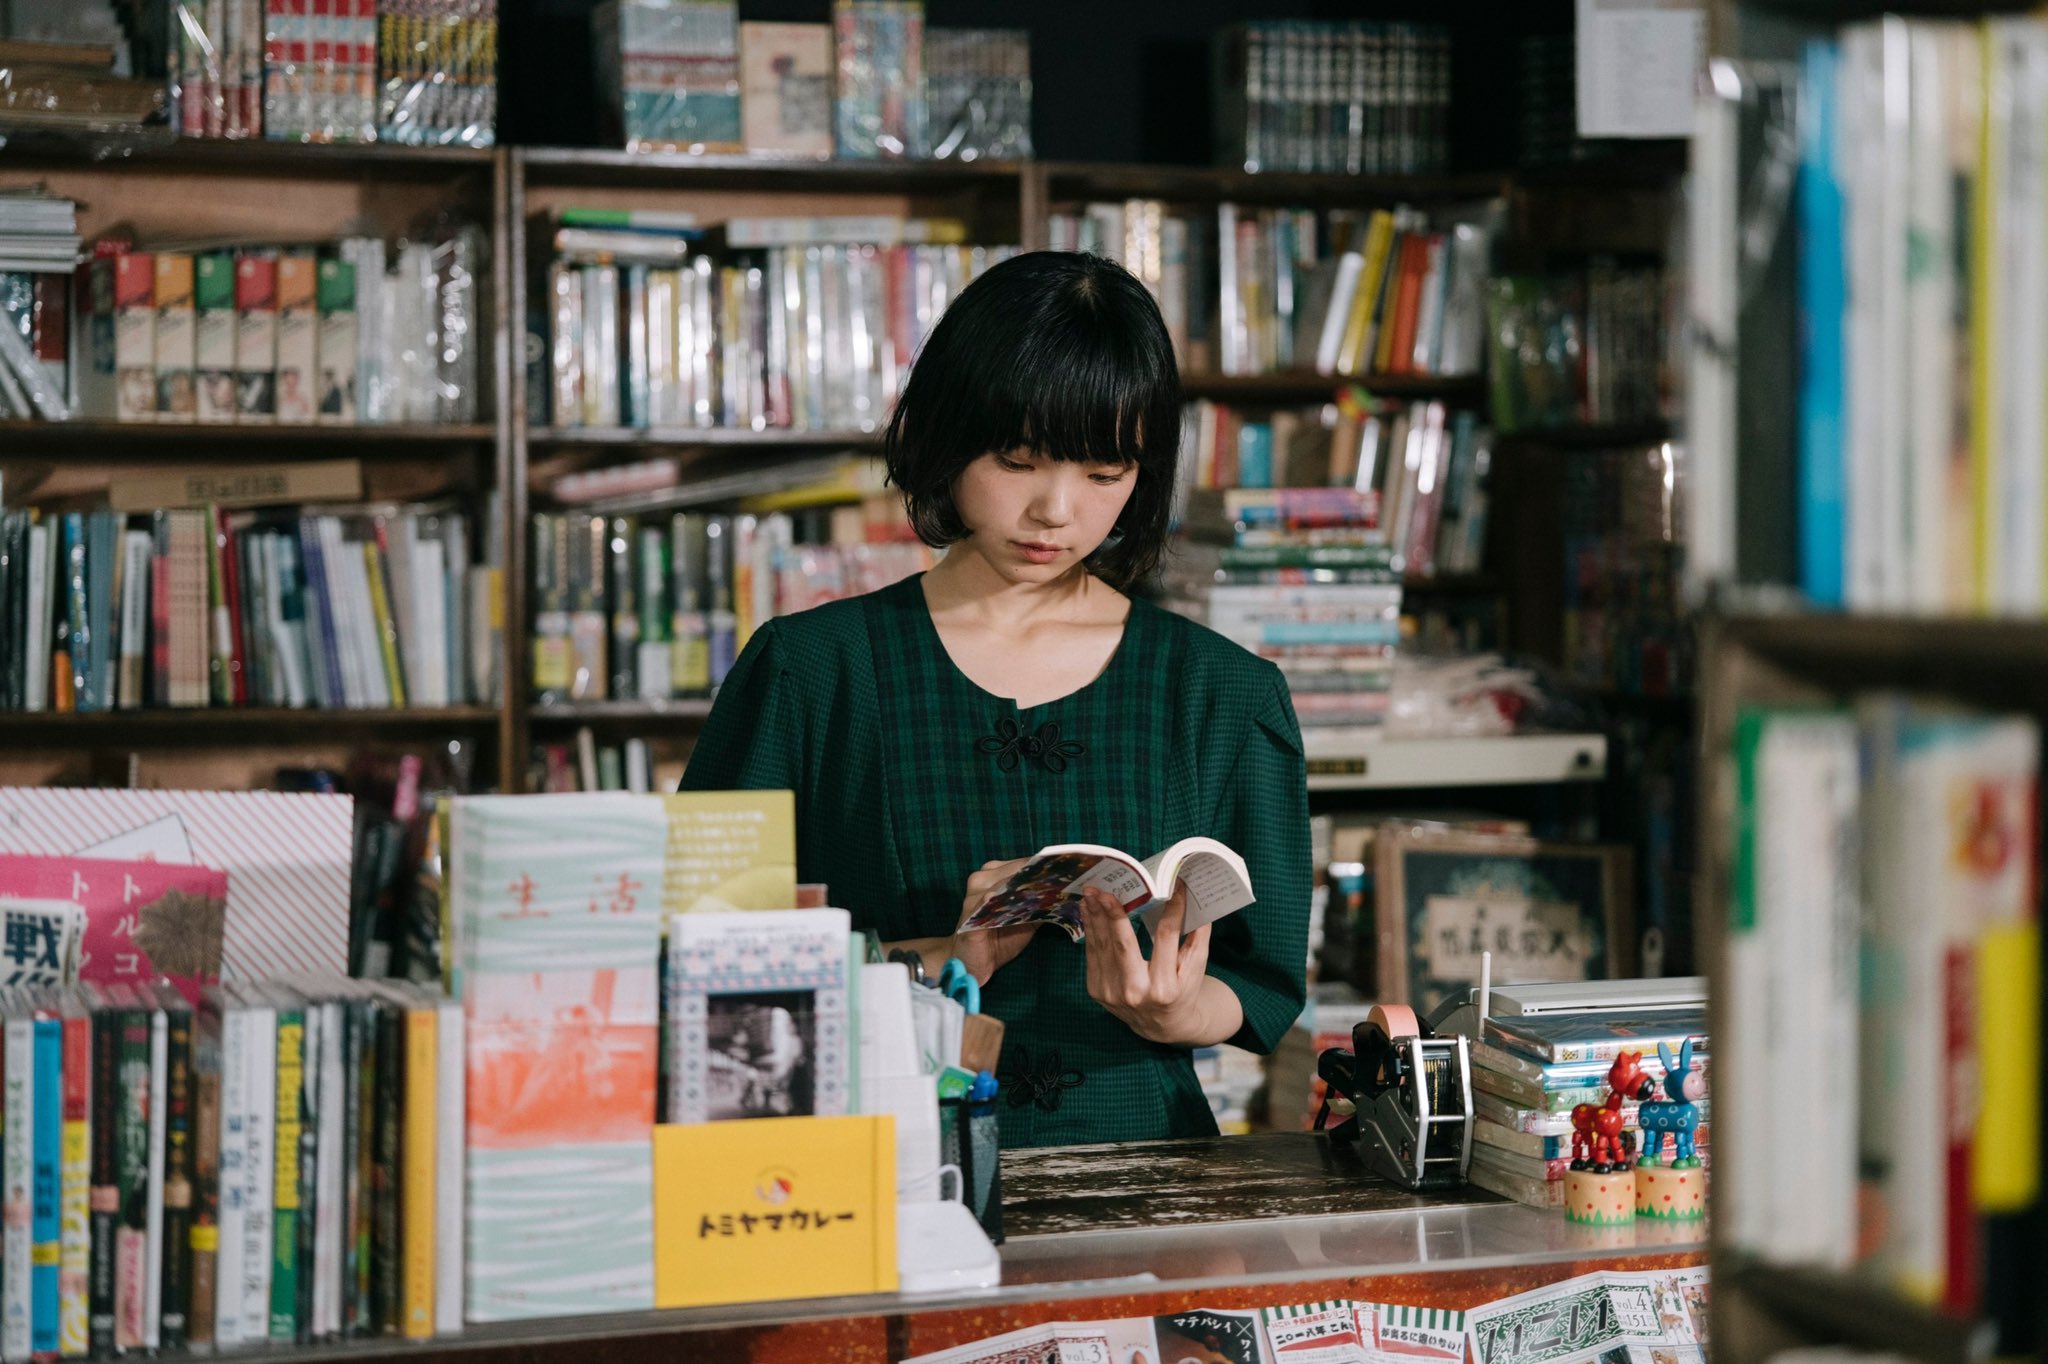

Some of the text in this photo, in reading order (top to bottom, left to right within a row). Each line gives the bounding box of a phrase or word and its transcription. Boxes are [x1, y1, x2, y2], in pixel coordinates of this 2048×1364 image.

[698, 1209, 855, 1238] トミヤマカレー
[1614, 1292, 1648, 1312] vol.4
[1173, 1316, 1232, 1334] マテバシイ
[1484, 1299, 1609, 1364] いこい
[1064, 1343, 1102, 1364] vol.3
